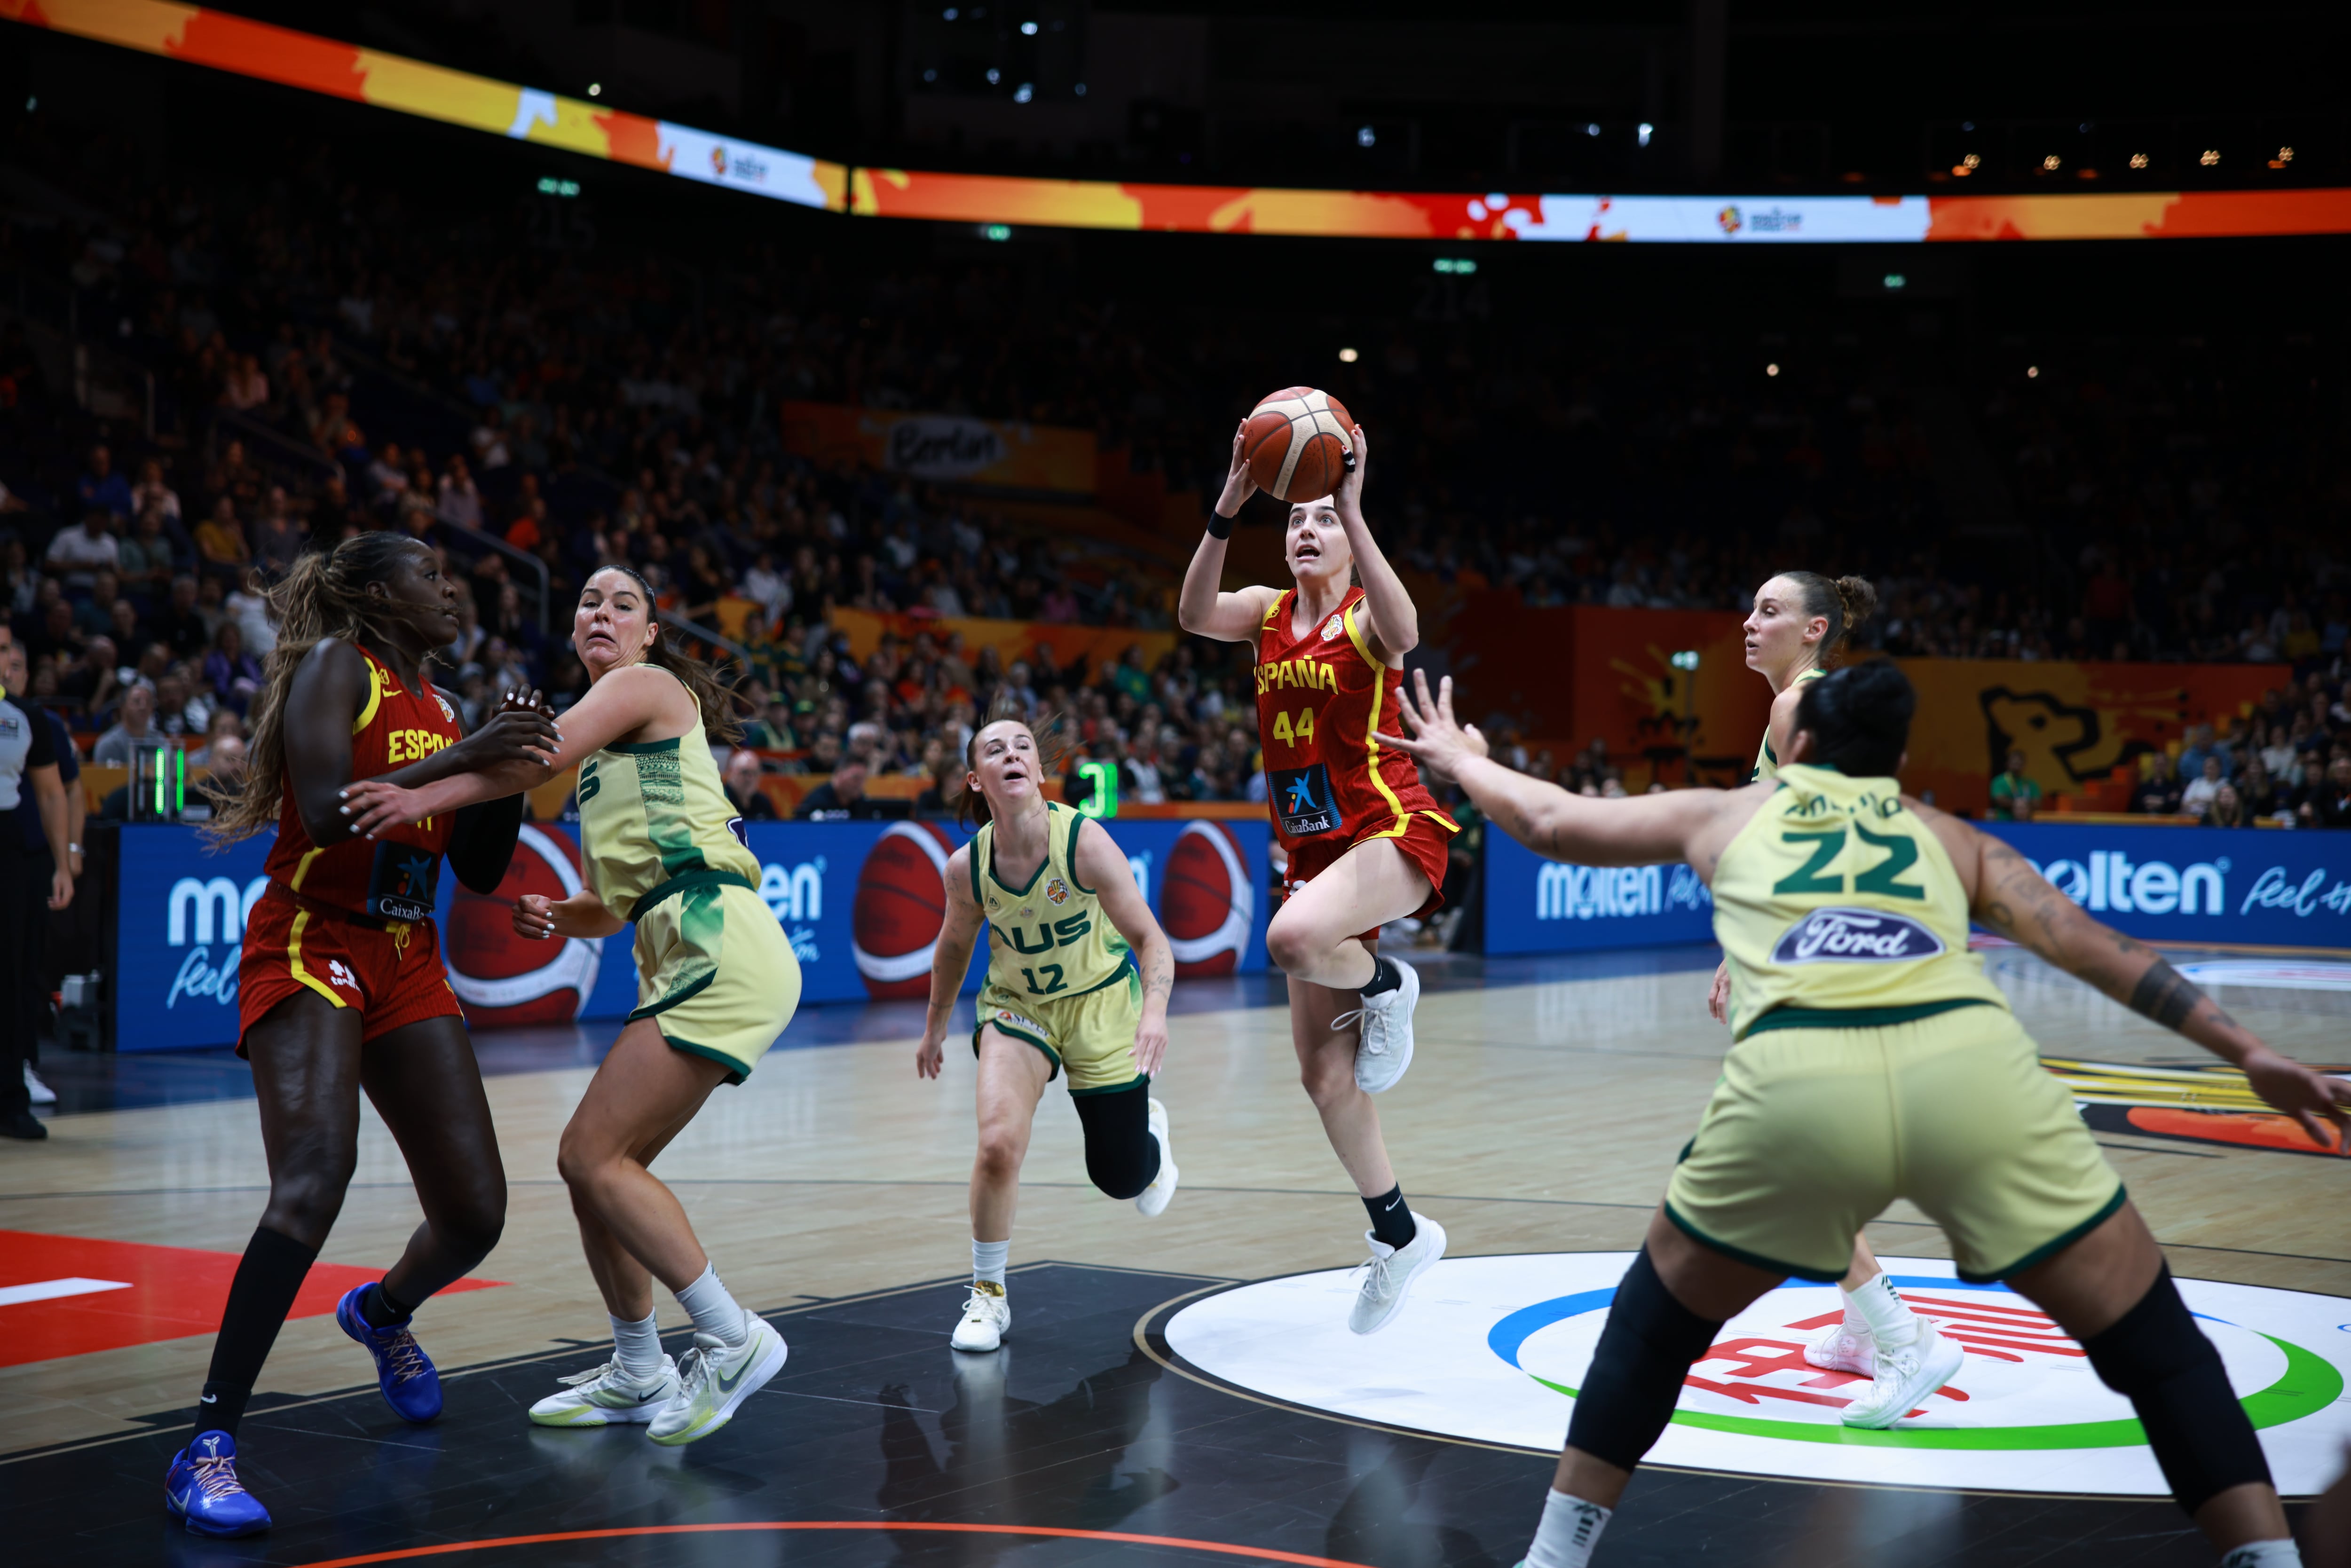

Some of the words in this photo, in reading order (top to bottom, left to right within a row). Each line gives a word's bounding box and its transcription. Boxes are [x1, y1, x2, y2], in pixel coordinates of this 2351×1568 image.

[1254, 654, 1339, 695] SPAÑA
[388, 729, 453, 764] ESPA
[1272, 707, 1314, 748] 44
[1285, 815, 1331, 834] CaixaBank
[1773, 819, 1925, 900] 22
[2023, 850, 2225, 916] olten
[1795, 914, 1910, 958] Ford
[1021, 963, 1068, 995] 12
